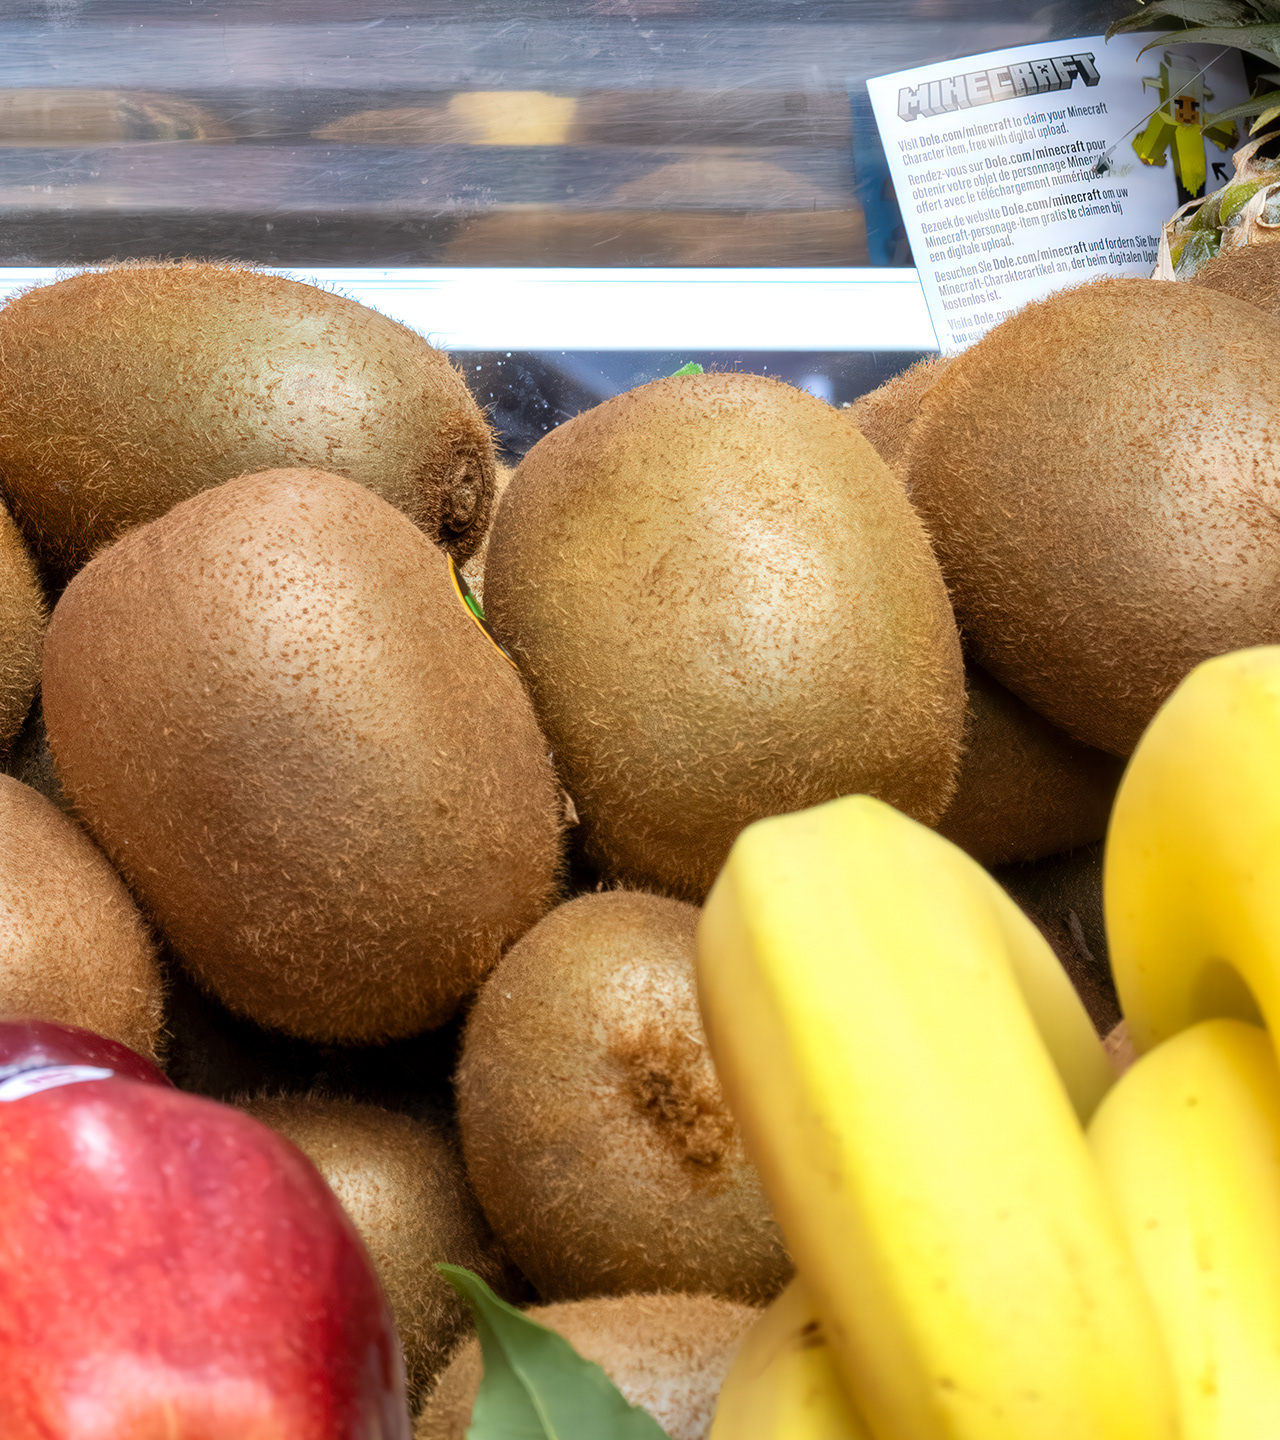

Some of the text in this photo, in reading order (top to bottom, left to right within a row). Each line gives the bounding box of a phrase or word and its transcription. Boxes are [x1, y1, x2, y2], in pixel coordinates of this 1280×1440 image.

[897, 52, 1100, 122] MINECRAFT
[898, 102, 1108, 152] Visit Dole.com/minecraft claim Minecraft
[1008, 125, 1069, 145] digital upload.
[984, 139, 1107, 170] Dole.com/minecraft pour
[1002, 189, 1102, 217] Dole.com/minecraft
[993, 240, 1087, 271] Dole.com/minecraft
